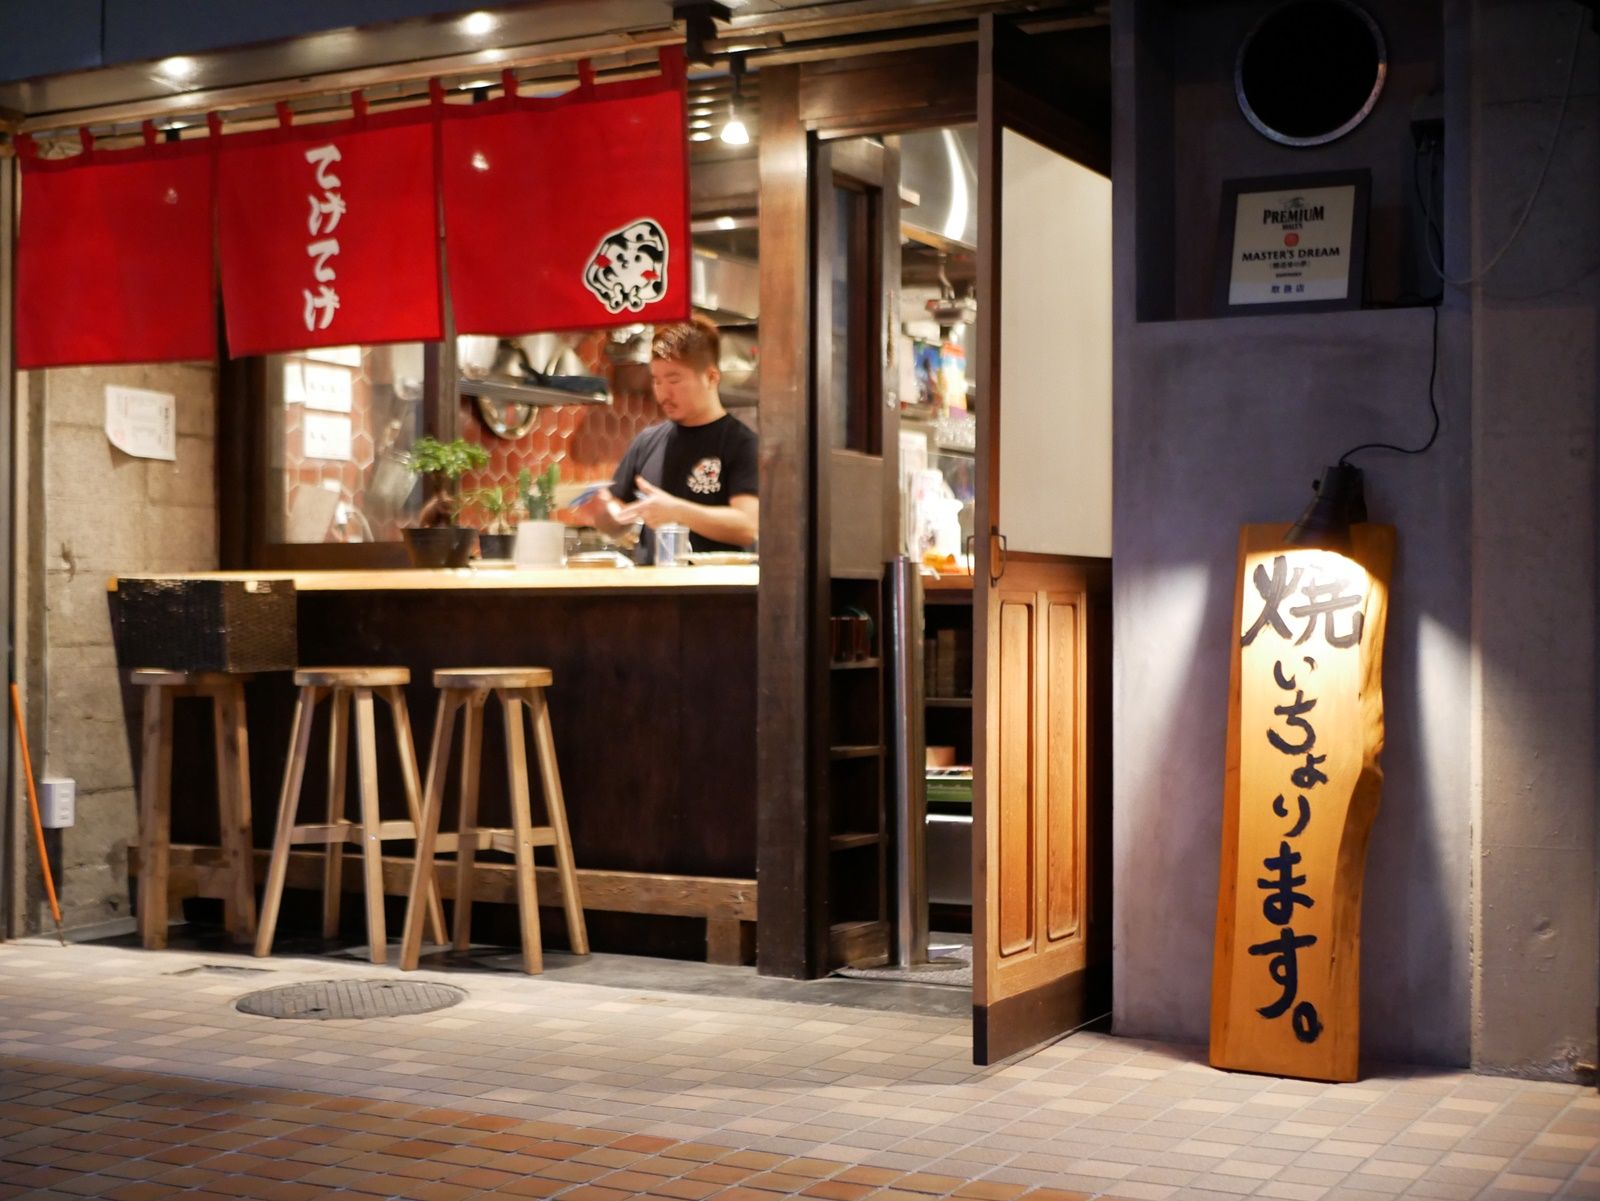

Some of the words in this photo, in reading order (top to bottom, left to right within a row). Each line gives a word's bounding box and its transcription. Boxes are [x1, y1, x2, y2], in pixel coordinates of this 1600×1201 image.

[1263, 206, 1325, 224] PREMIUM
[1242, 251, 1295, 262] MASTER'S
[1298, 247, 1340, 258] DREAM
